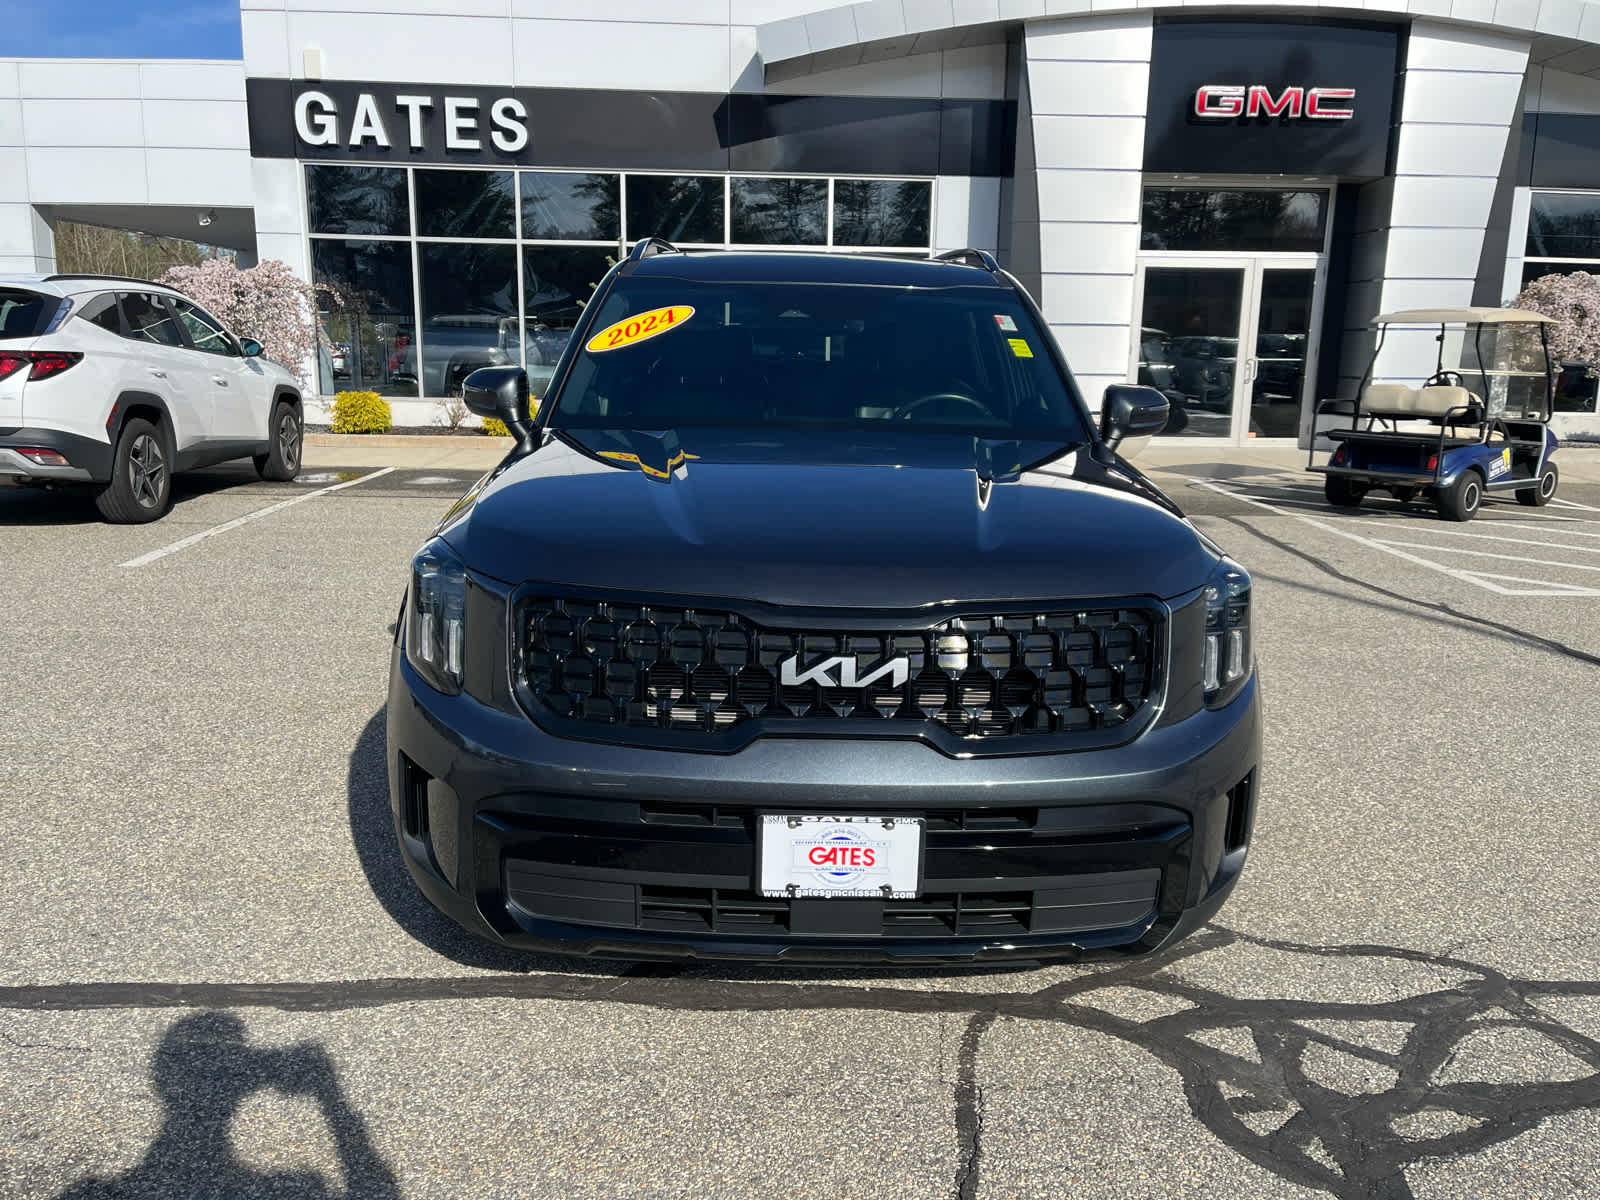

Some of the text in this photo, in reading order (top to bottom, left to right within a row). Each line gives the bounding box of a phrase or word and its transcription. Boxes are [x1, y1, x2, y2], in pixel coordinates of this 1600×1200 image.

[1195, 85, 1356, 120] GMC
[294, 90, 529, 152] GATES
[607, 309, 676, 347] 2024
[781, 654, 909, 688] KIA
[801, 816, 883, 824] GATES
[893, 817, 919, 825] GMC
[808, 846, 876, 867] GATES
